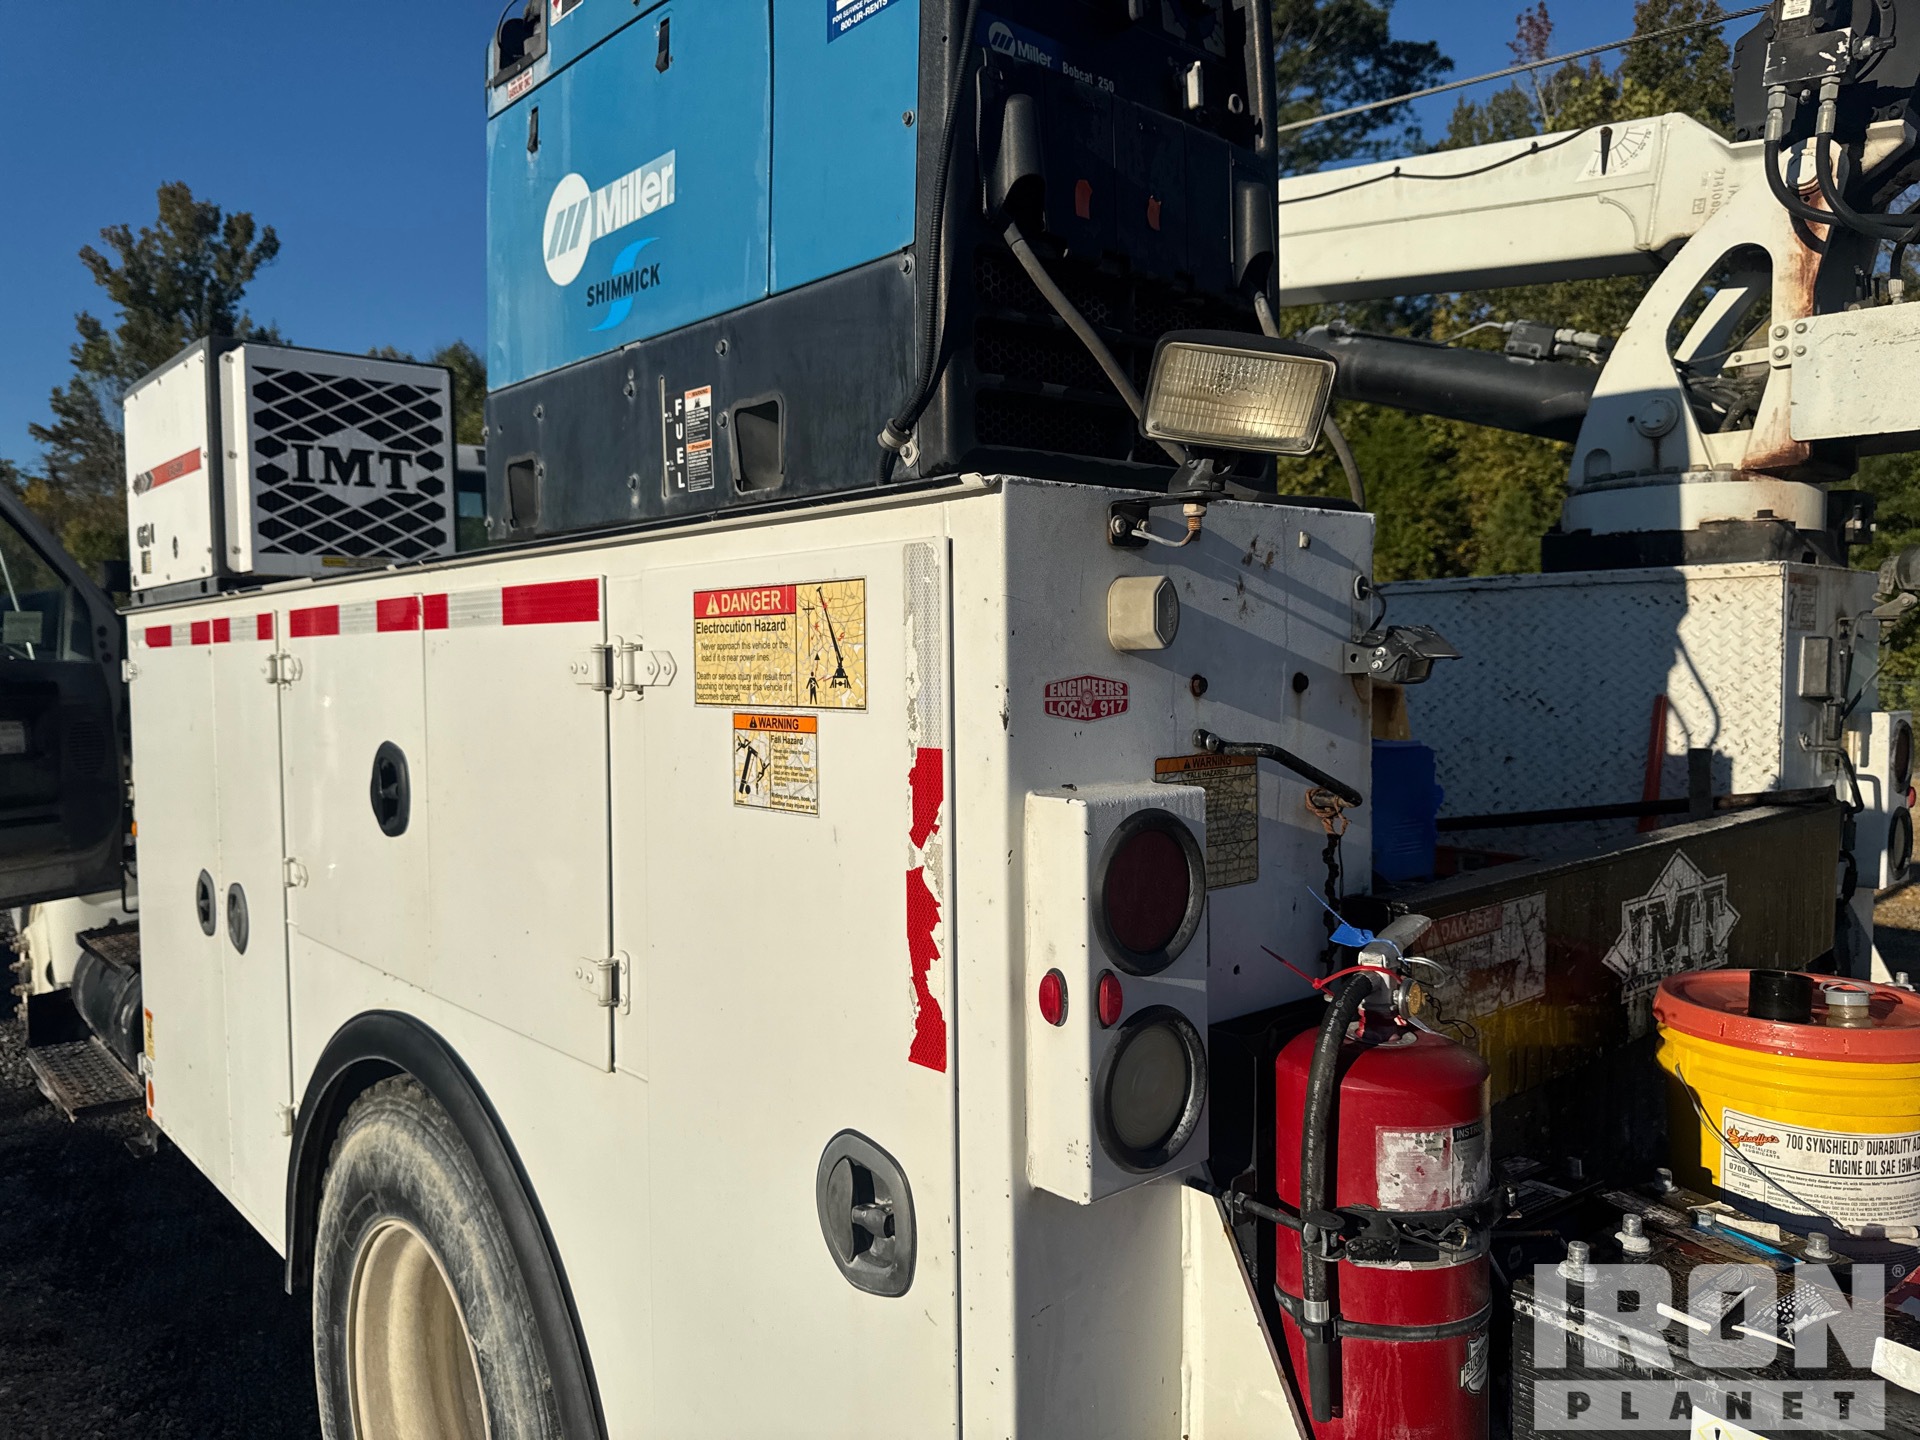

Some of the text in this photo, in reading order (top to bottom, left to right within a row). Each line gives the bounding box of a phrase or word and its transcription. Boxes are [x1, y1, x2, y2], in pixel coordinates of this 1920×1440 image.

[832, 12, 843, 24] FOR
[843, 1, 864, 18] SERVICE
[840, 0, 888, 31] 800-UR-RENTS
[1017, 40, 1053, 68] Miller
[1062, 61, 1115, 93] Bobcat 250
[596, 162, 674, 238] Miller
[586, 263, 661, 307] SHIMMICK
[291, 443, 413, 491] IMT
[721, 590, 781, 613] DANGER
[696, 618, 786, 635] Electrocution Hazard
[701, 642, 716, 650] Never
[717, 641, 740, 651] approach
[742, 641, 751, 650] this
[752, 641, 771, 650] vehicle
[739, 654, 755, 663] power
[696, 671, 711, 680] Death
[724, 683, 739, 692] being
[740, 683, 752, 691] near
[1049, 678, 1124, 697] ENGINEERS
[1049, 700, 1124, 718] LOCAL 917
[759, 717, 799, 730] WARNING
[771, 735, 803, 745] Fall Hazard
[1192, 755, 1232, 768] WARNING
[1187, 768, 1228, 779] FALL HAZARDS
[1440, 911, 1493, 941] DANGER
[1727, 1126, 1780, 1147] Schaeffer's
[1786, 1133, 1803, 1150] 700
[1866, 1138, 1911, 1156] DURABILITY
[1742, 1143, 1777, 1155] SPECIALIZED
[1745, 1148, 1781, 1159] LUBRICANTS
[1829, 1159, 1863, 1176] ENGINE
[1865, 1160, 1878, 1176] OIL
[1880, 1159, 1896, 1176] SAE
